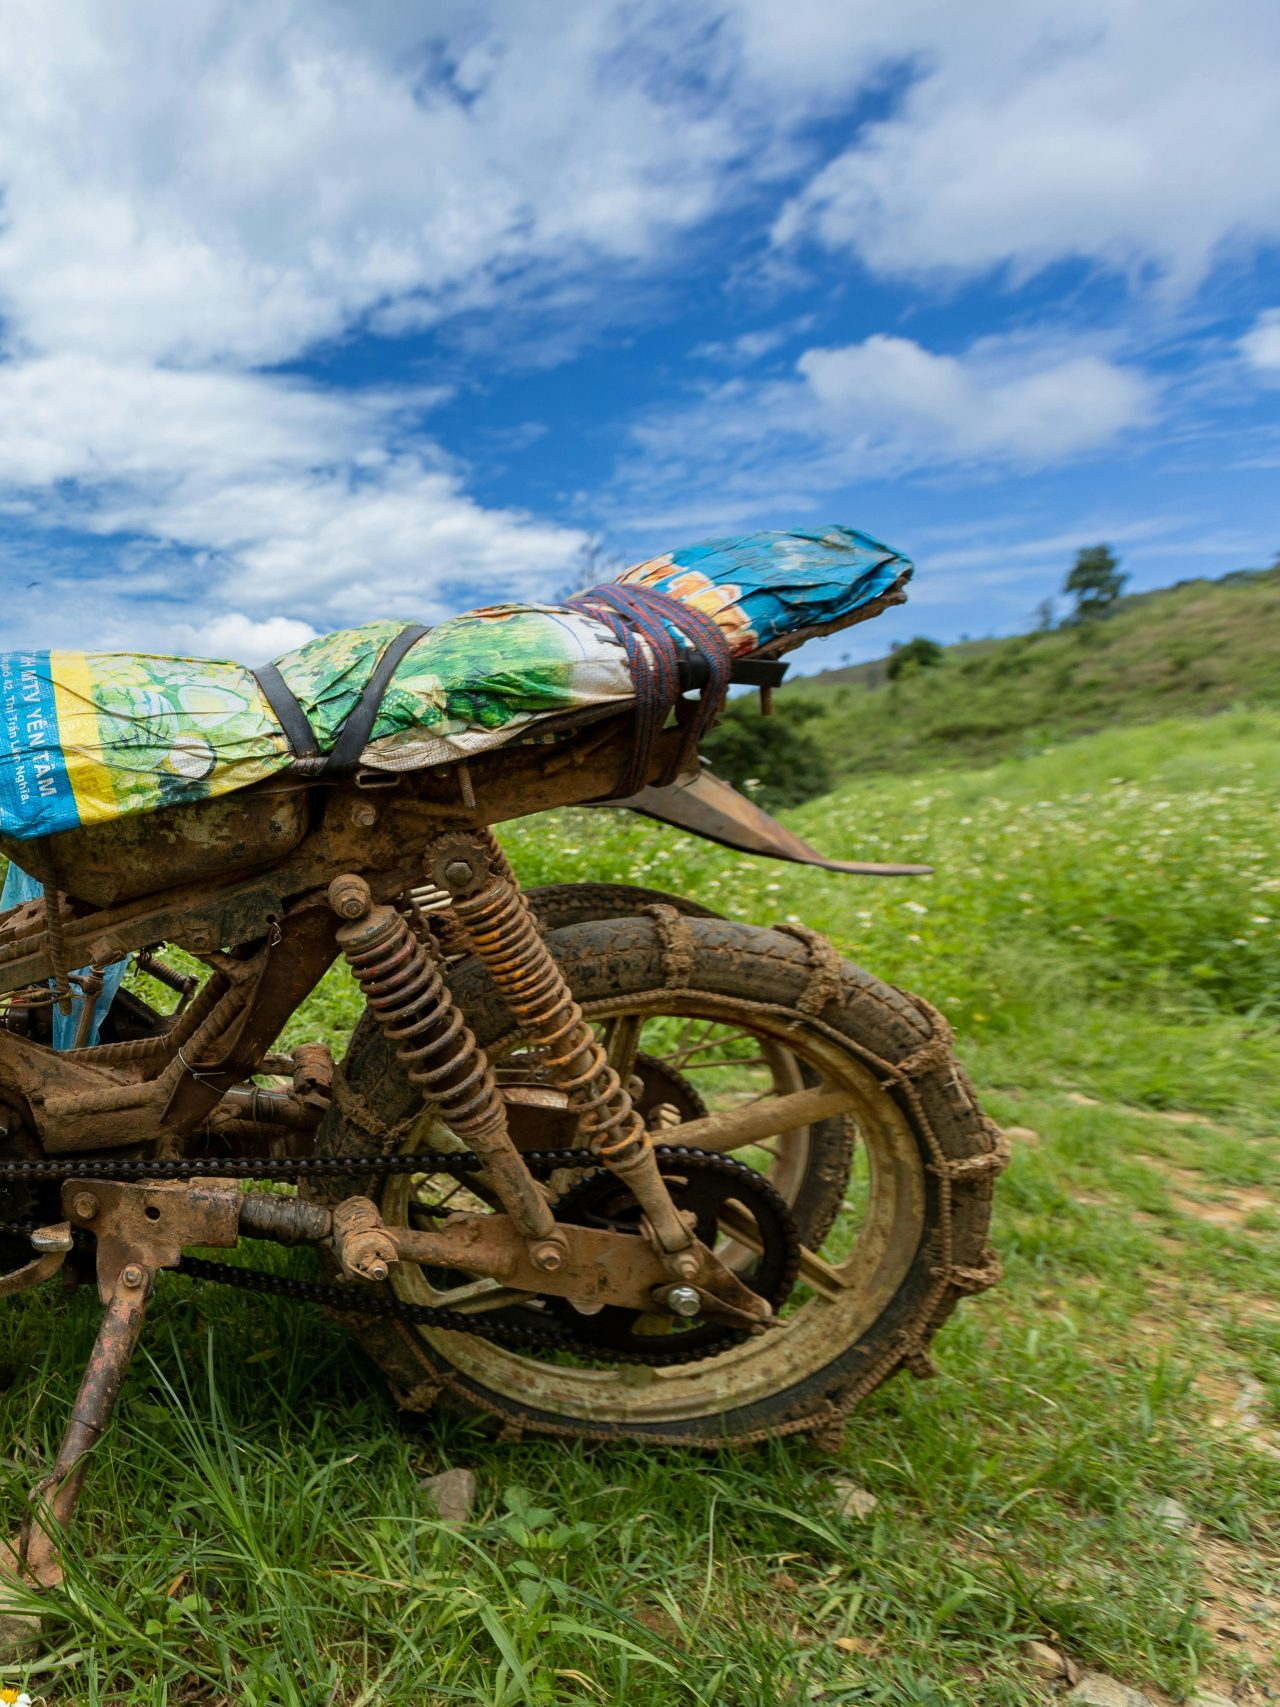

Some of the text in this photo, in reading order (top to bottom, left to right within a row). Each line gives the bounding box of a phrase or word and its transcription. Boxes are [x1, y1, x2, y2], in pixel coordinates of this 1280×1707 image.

[20, 669, 41, 702] MTV
[26, 708, 47, 750] YÊN
[32, 751, 57, 797] TÂM
